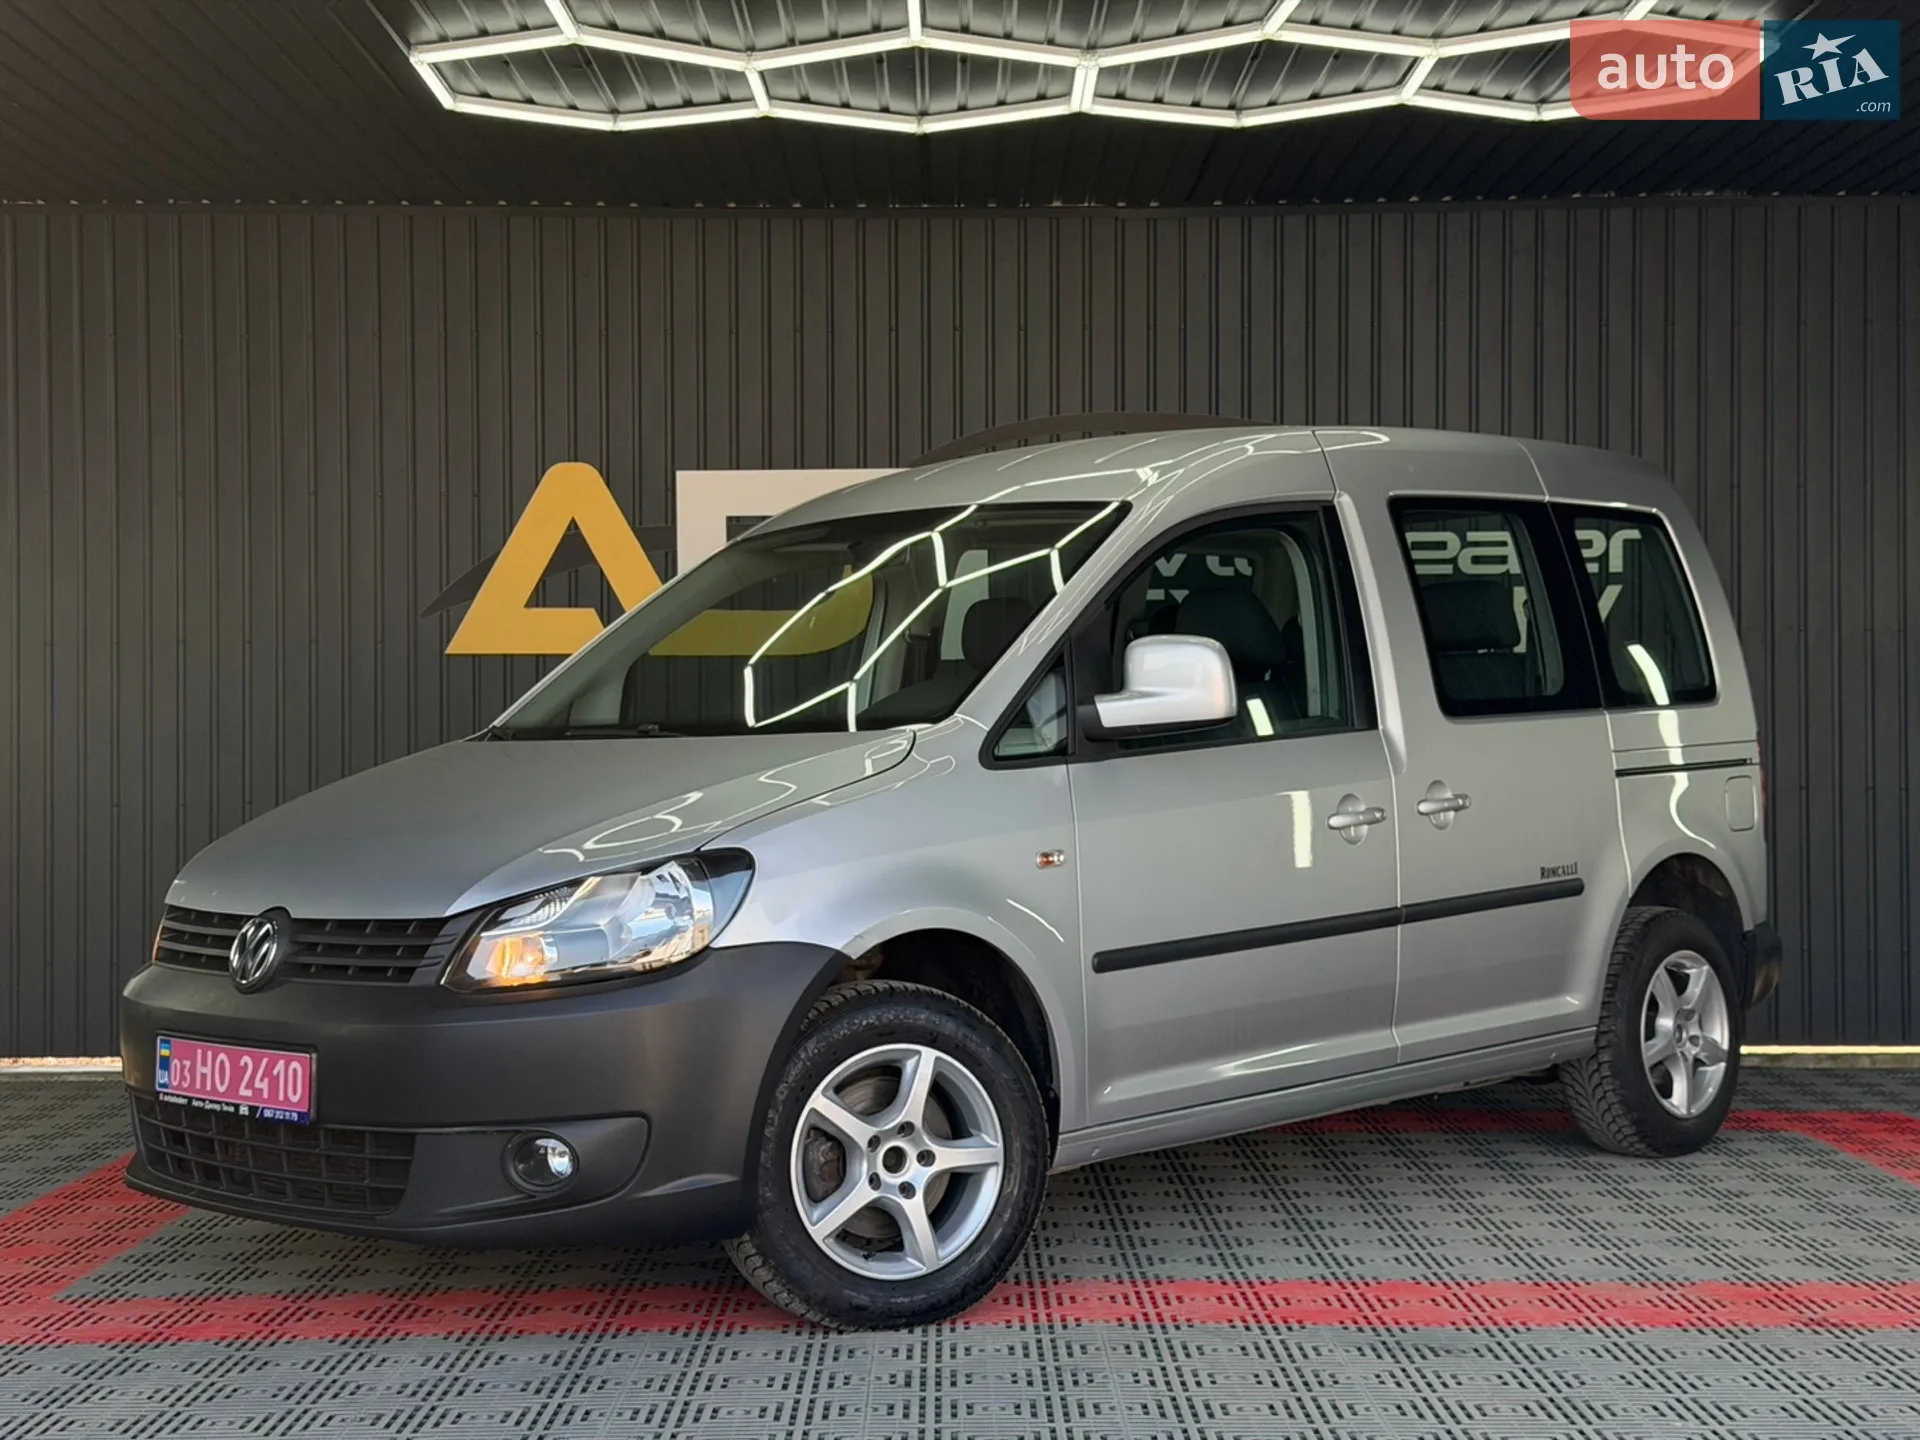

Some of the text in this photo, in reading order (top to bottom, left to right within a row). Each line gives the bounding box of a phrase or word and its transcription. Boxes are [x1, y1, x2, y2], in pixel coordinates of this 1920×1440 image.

[158, 1069, 169, 1085] UA
[170, 1049, 303, 1103] 03 HO 2410
